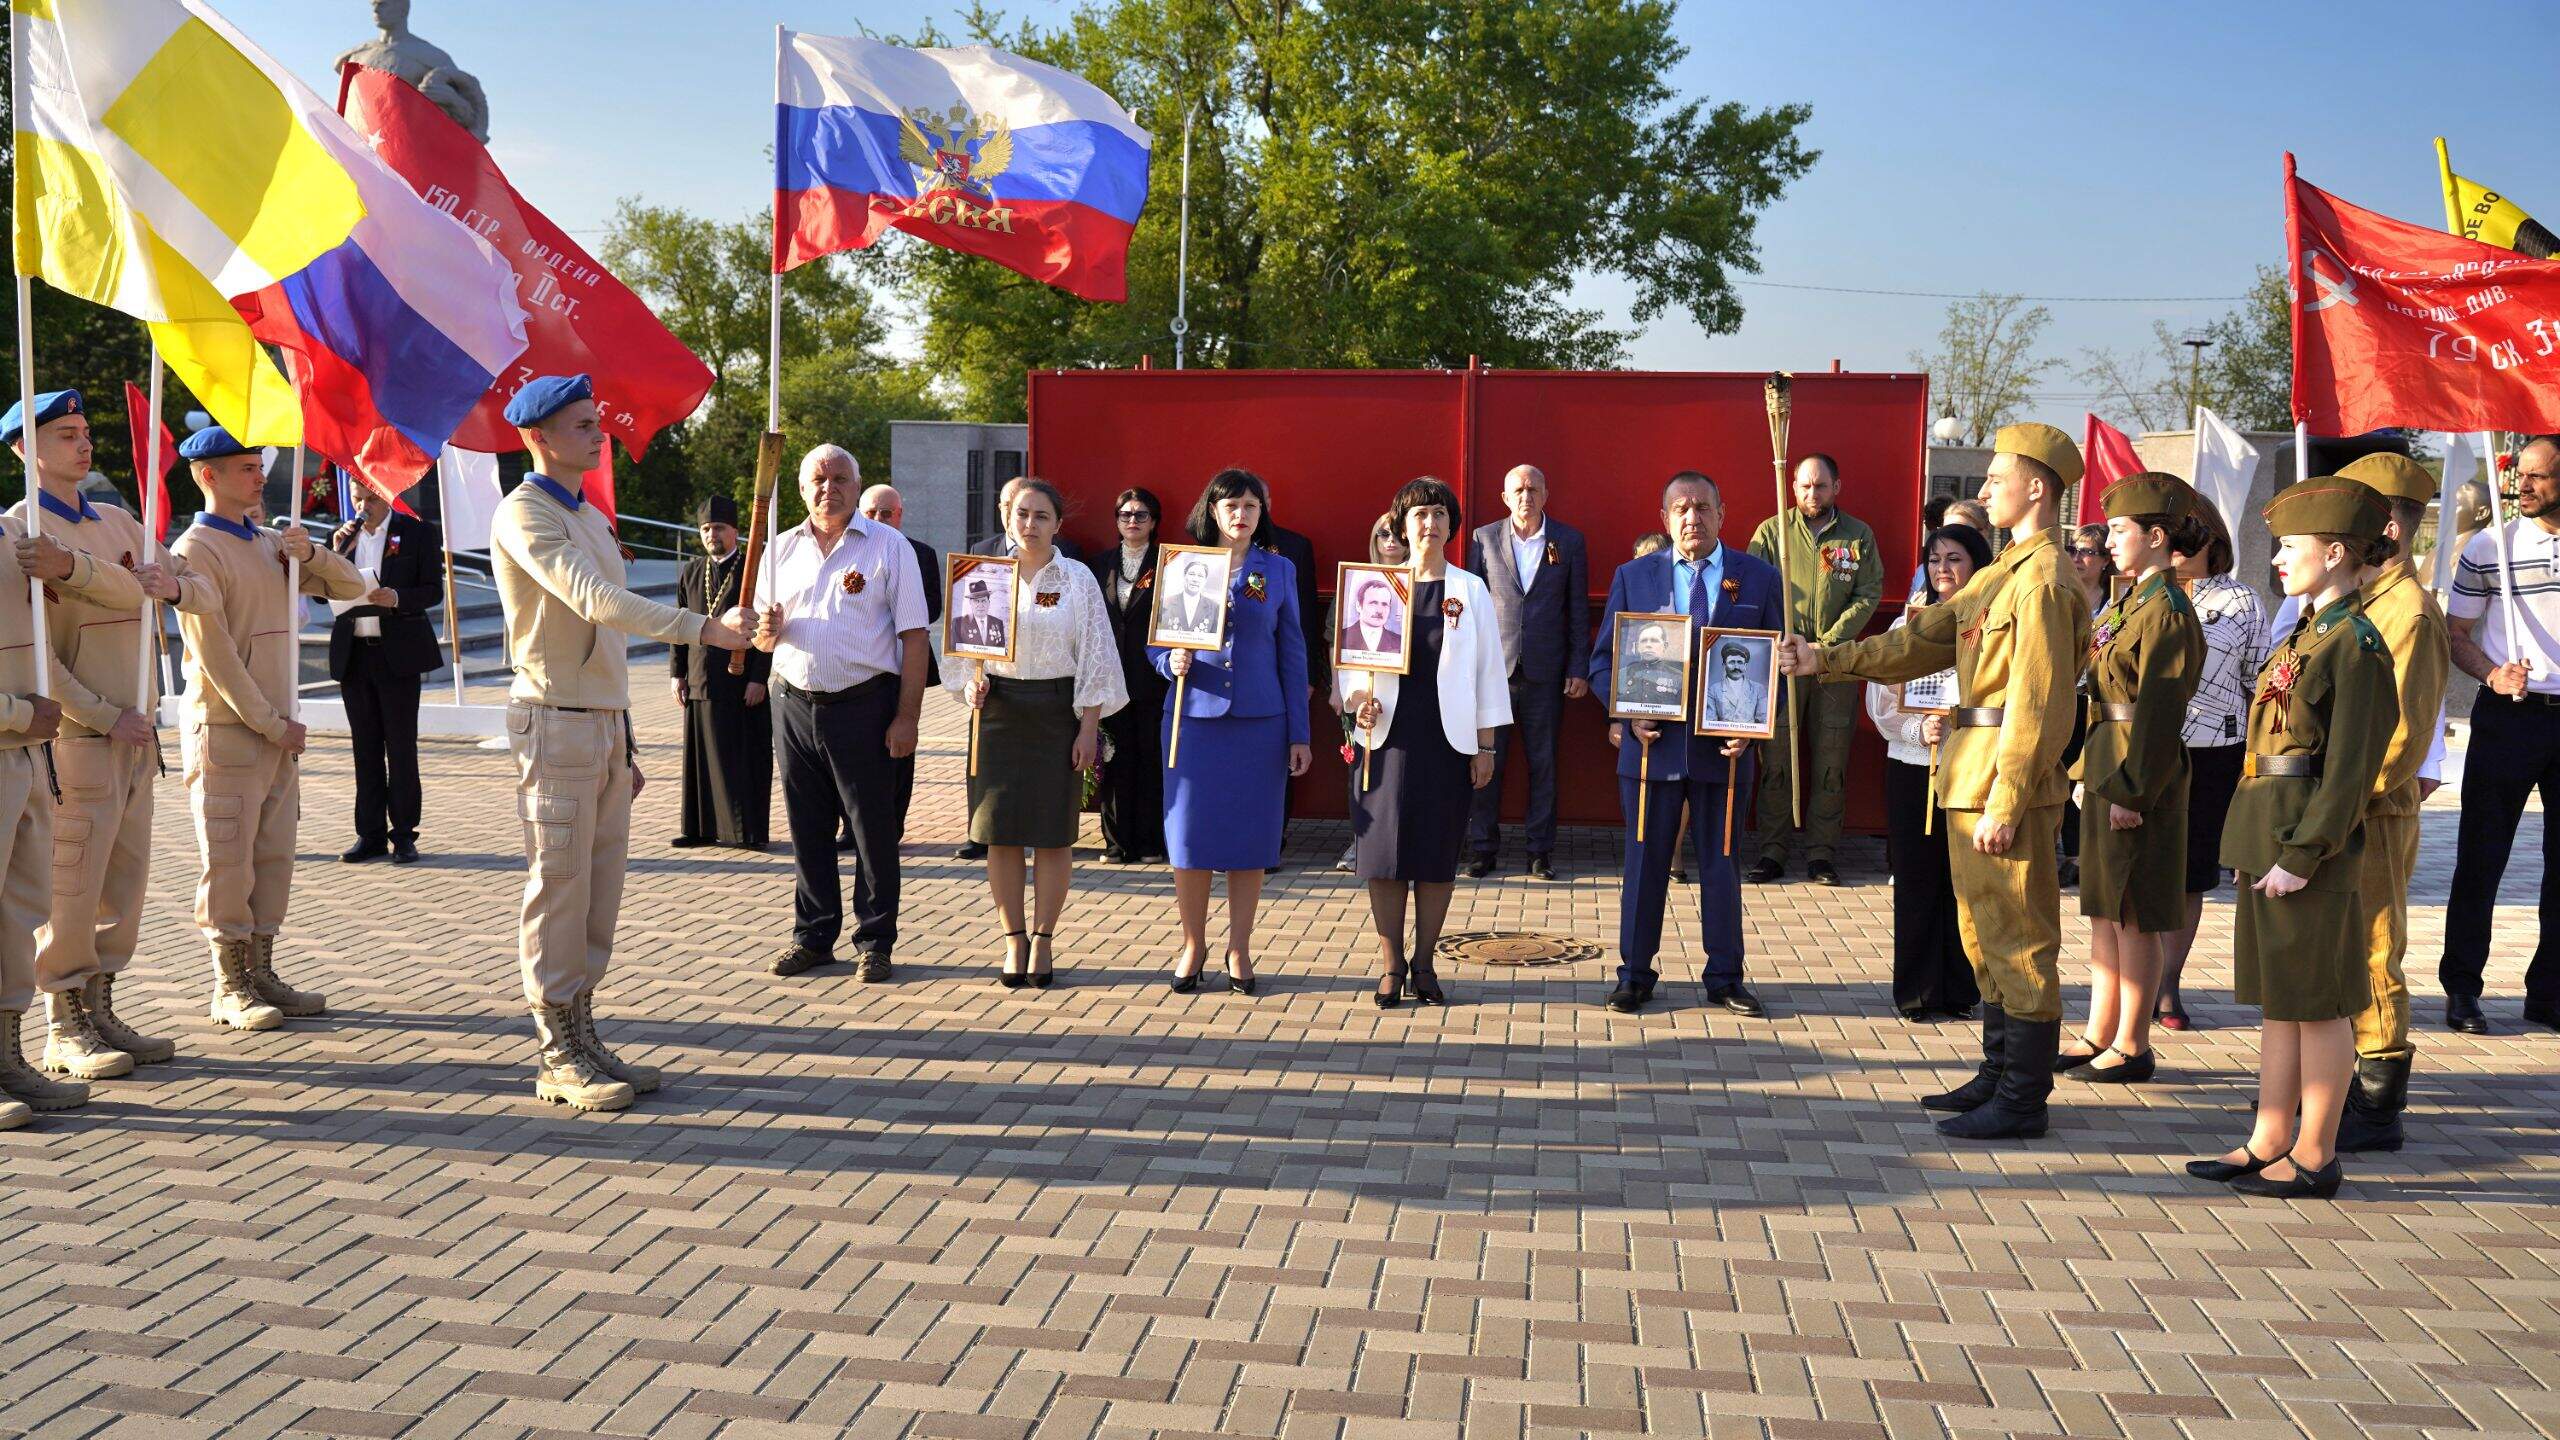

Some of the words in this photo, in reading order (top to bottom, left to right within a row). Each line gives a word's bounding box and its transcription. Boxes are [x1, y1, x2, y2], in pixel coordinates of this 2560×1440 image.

[423, 184, 460, 214] 150
[461, 209, 501, 242] СТР.
[521, 239, 600, 287] ОРДЕНА
[2466, 285, 2514, 315] ДИВ.
[2423, 326, 2478, 362] 79
